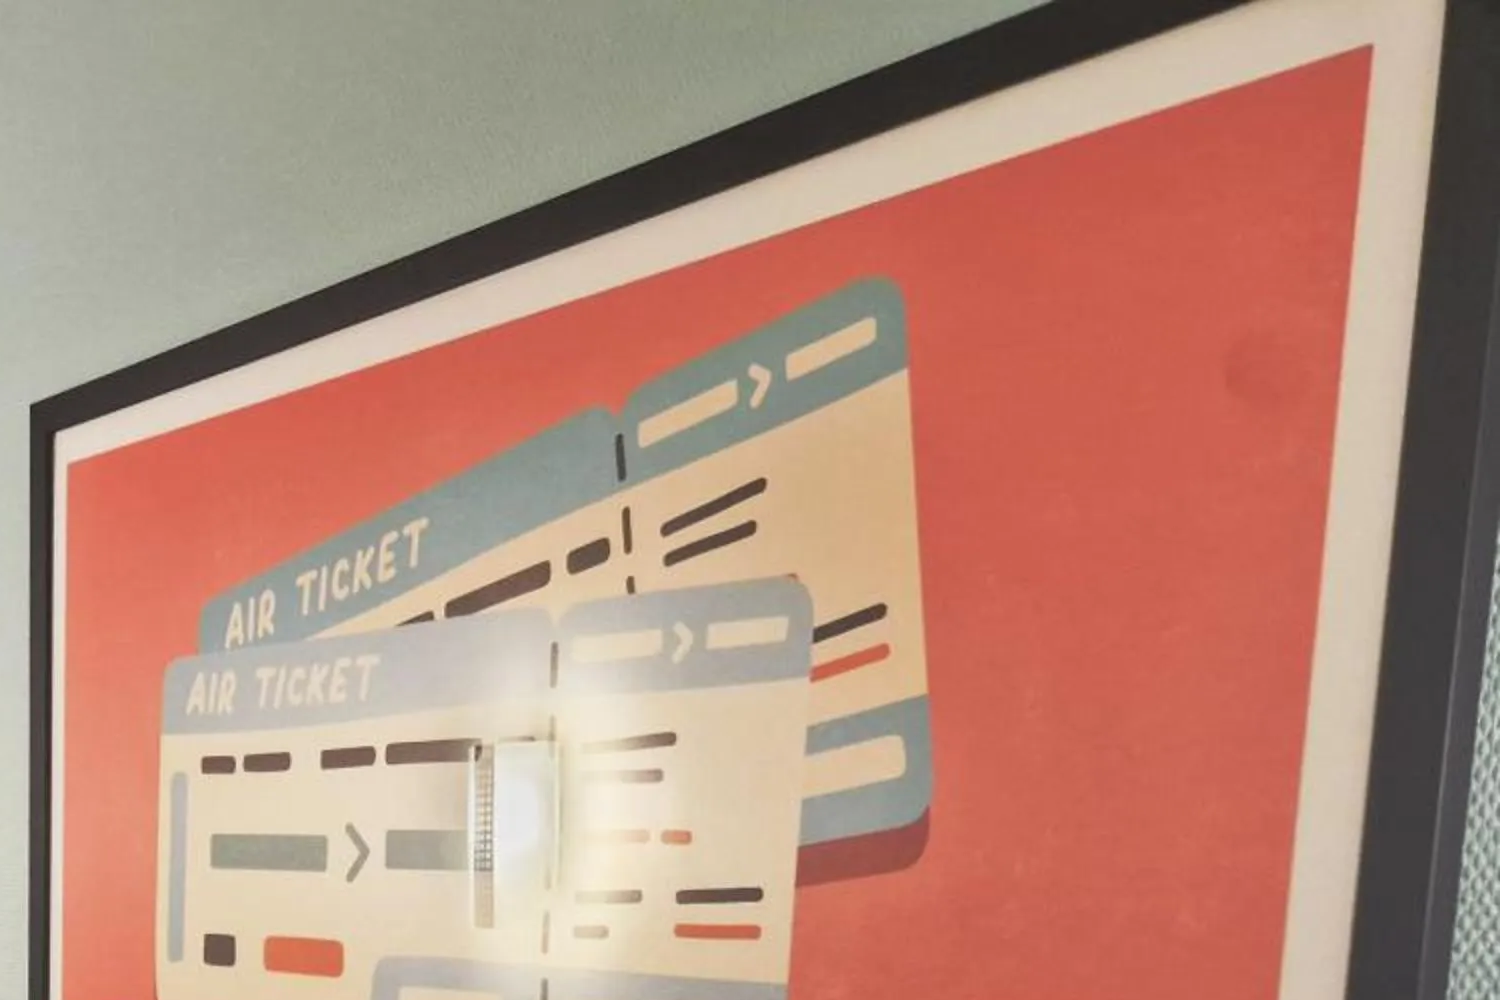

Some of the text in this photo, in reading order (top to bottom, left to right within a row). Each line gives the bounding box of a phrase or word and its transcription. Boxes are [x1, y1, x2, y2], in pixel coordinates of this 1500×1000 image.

[225, 516, 429, 649] AIR TICKET
[186, 654, 381, 716] AIR TICKET
